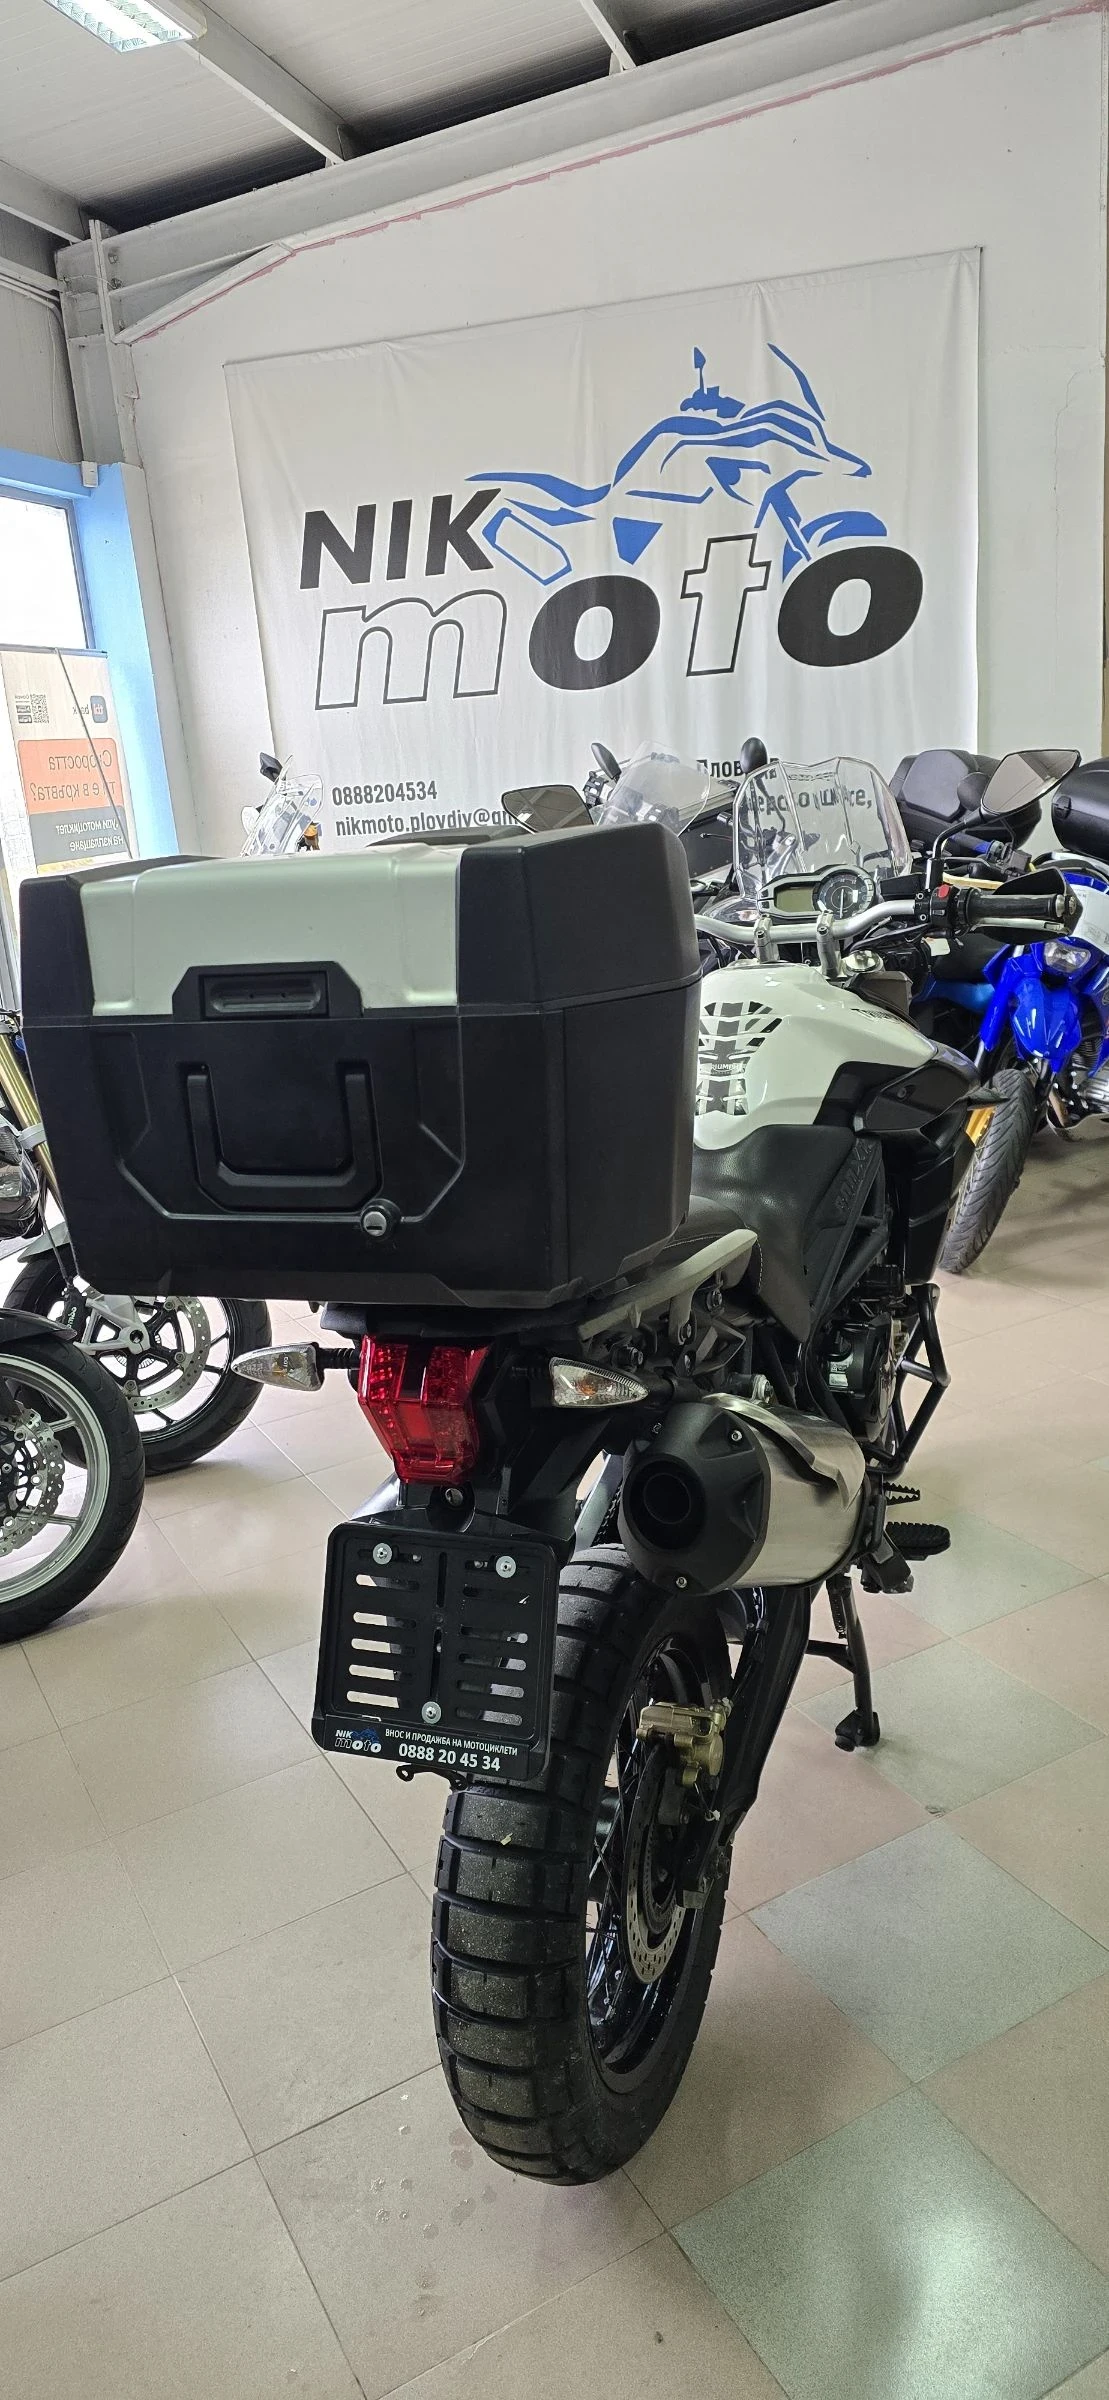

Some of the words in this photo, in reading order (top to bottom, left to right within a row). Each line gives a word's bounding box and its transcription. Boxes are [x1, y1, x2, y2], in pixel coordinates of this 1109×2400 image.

[300, 487, 502, 589] NIK
[314, 531, 924, 711] moto
[331, 780, 438, 806] 0888204534
[335, 808, 519, 837] nikmoto.plovdiv@gm
[334, 1737, 382, 1754] moto
[335, 1729, 353, 1738] NIK
[385, 1728, 405, 1739] ВНОС
[405, 1732, 411, 1740] И
[411, 1732, 451, 1747] ПРОДАЖБА
[452, 1738, 463, 1748] НА
[463, 1740, 518, 1757] МОТОЦИКЛЕТИ
[398, 1743, 435, 1761] 0888
[438, 1749, 457, 1765] 20
[459, 1752, 478, 1768] 45
[481, 1755, 501, 1772] 34
